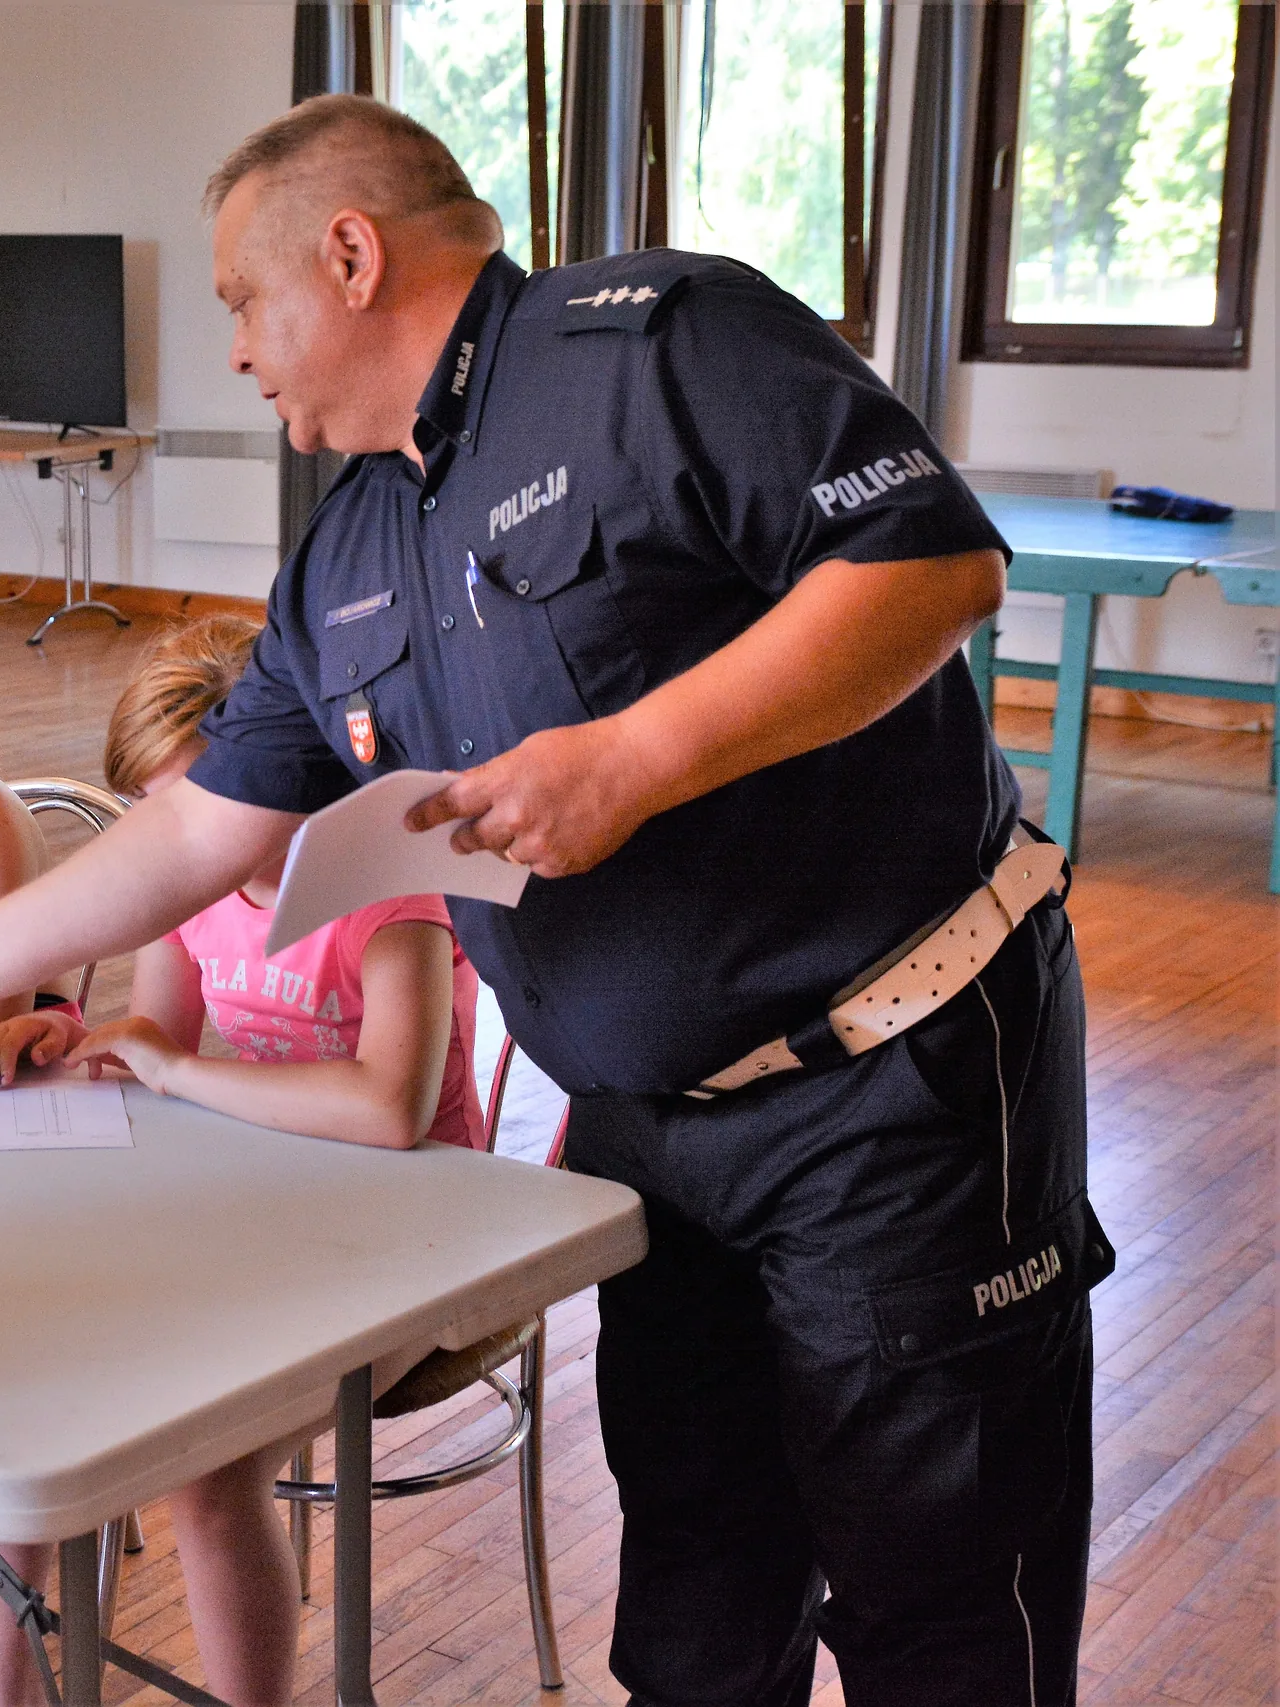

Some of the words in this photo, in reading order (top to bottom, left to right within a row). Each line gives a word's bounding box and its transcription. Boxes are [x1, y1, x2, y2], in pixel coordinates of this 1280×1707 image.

[451, 341, 475, 396] POLICJA
[489, 465, 568, 541] POLICJA
[810, 448, 942, 517] POLICJA
[198, 959, 247, 992] LA
[261, 964, 343, 1022] HULA
[973, 1244, 1063, 1317] POLICJA
